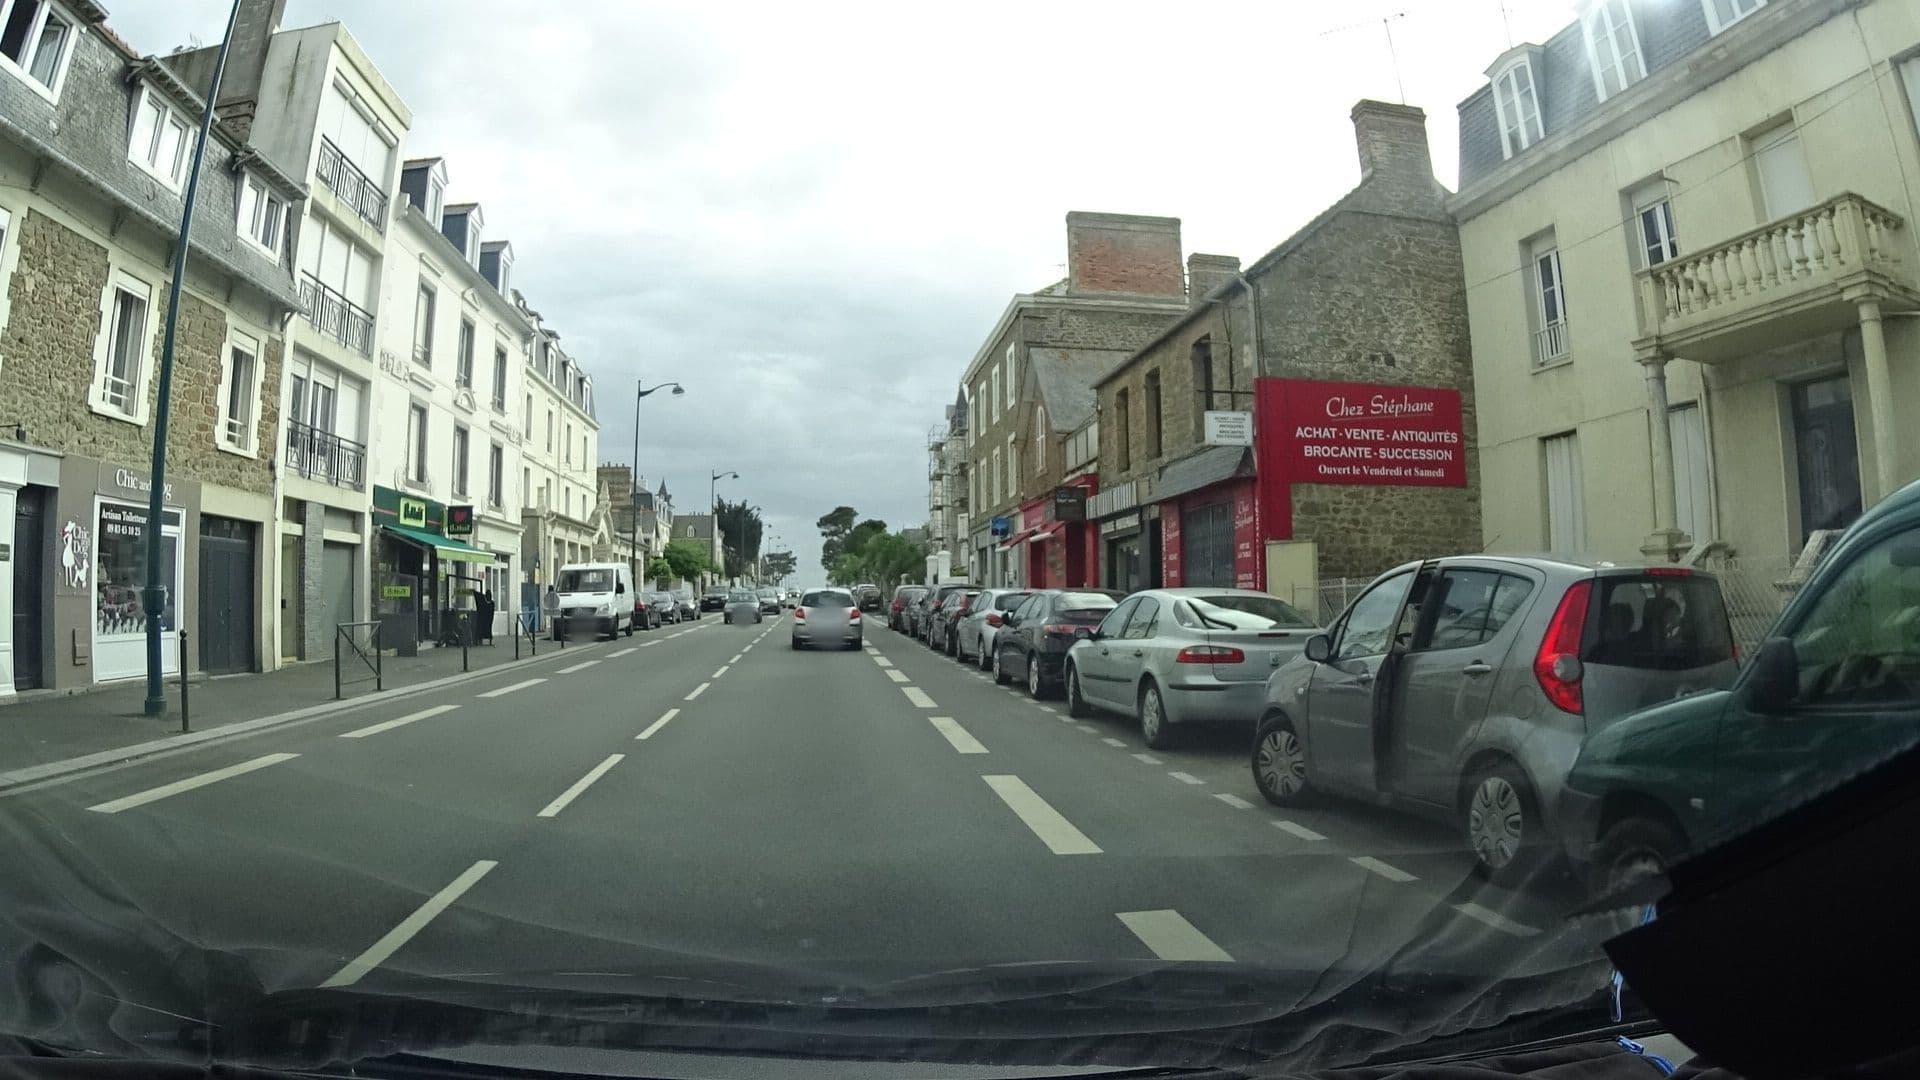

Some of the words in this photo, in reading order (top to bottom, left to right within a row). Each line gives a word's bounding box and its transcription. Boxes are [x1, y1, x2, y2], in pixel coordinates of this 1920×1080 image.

[1326, 396, 1364, 417] Chez
[1370, 394, 1434, 417] Stéphane
[1295, 427, 1337, 439] ACHAT
[1344, 428, 1385, 441] VENTE
[1391, 429, 1458, 444] ANTIQUITÉS
[1304, 445, 1372, 459] BROCANTE
[1379, 449, 1453, 461] SUCCESSION
[1318, 464, 1351, 476] Ouvert
[1352, 464, 1361, 475] le
[1363, 465, 1403, 477] Vendredi
[1404, 466, 1413, 477] et
[1414, 466, 1445, 478] Samedi
[116, 468, 138, 489] Chic
[139, 479, 152, 491] and
[101, 508, 122, 520] Artisan
